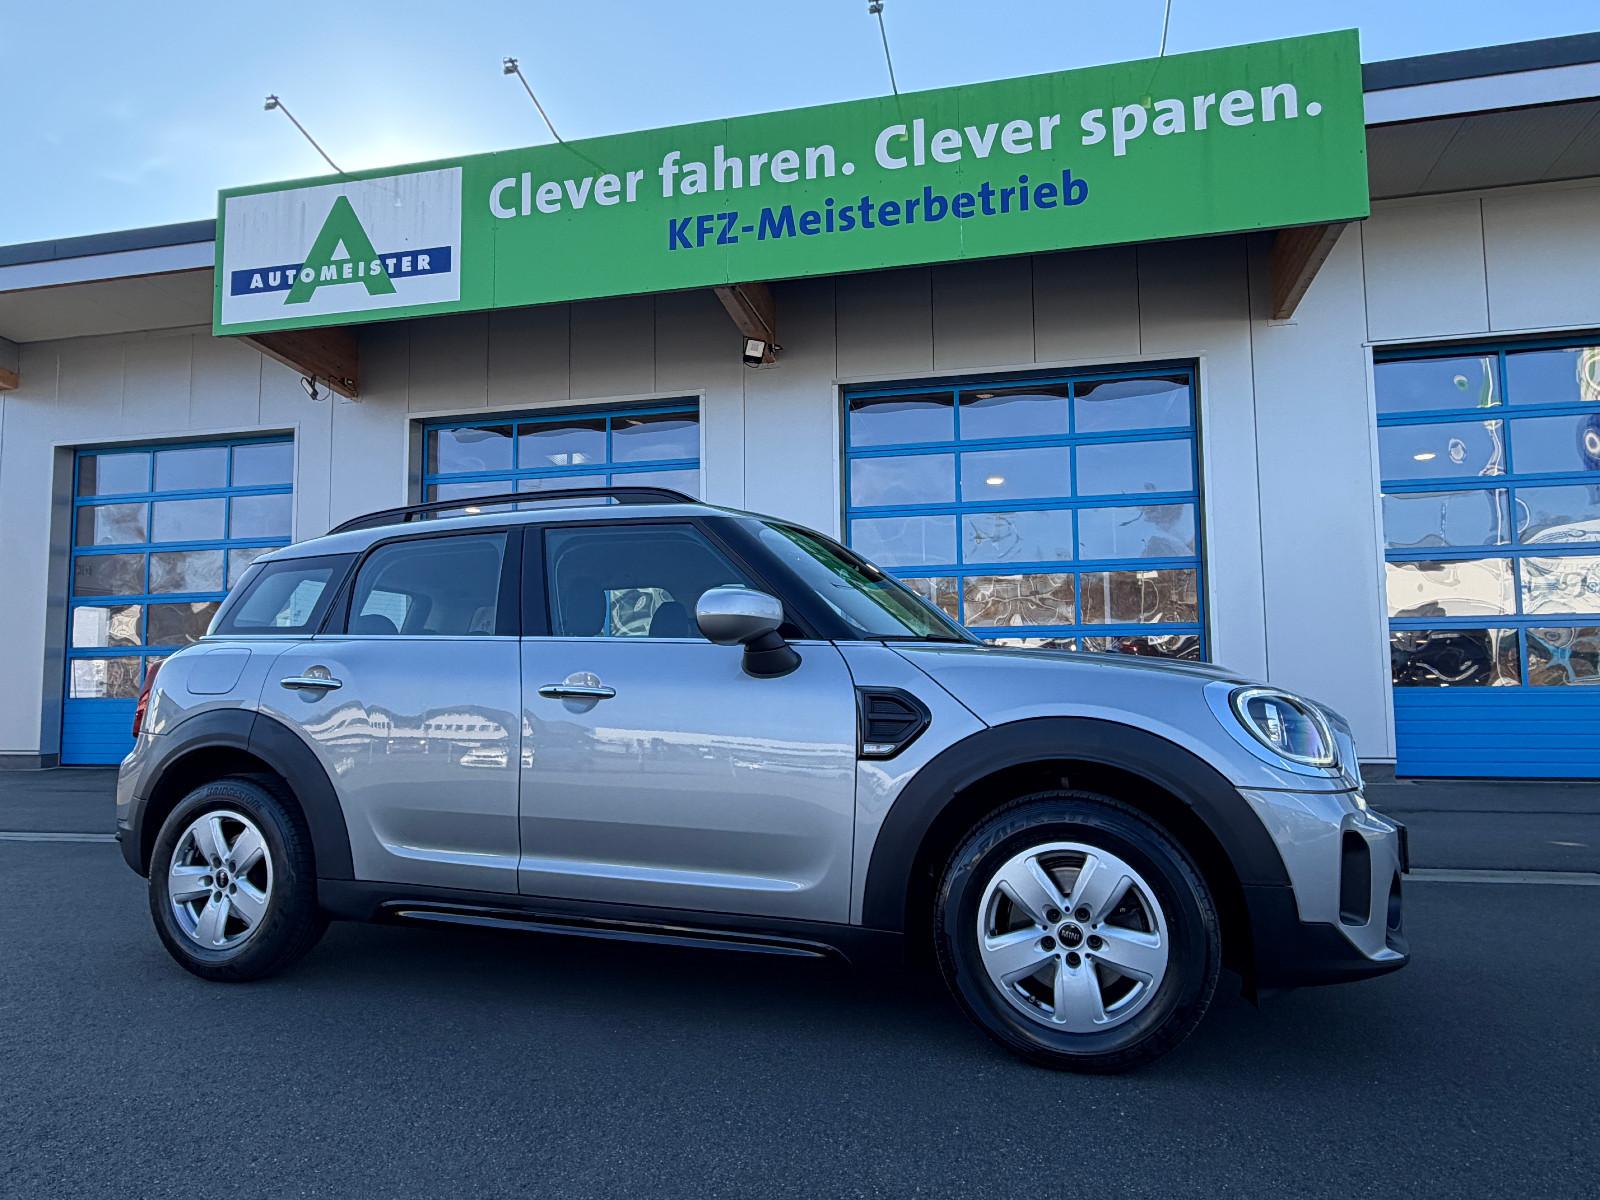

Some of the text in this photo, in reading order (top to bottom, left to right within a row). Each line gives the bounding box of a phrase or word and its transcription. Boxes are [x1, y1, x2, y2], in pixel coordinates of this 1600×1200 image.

[488, 83, 1323, 220] Clever fahren. Clever sparen.
[668, 169, 1089, 251] KFZ-Meisterbetrieb
[249, 254, 432, 289] AUTOMEISTER
